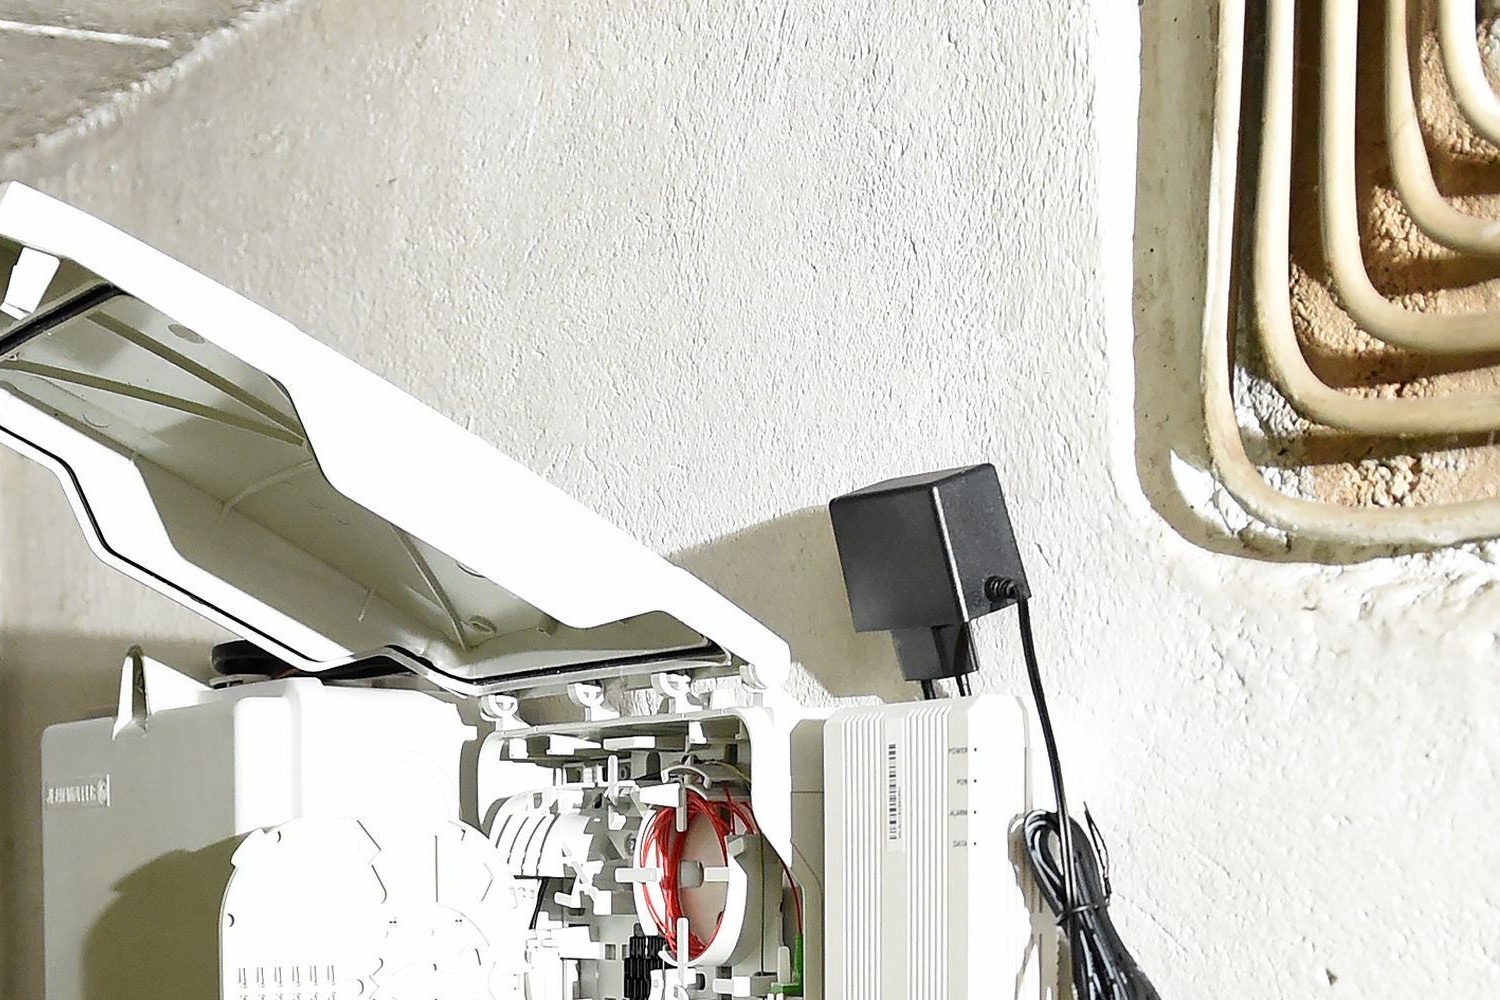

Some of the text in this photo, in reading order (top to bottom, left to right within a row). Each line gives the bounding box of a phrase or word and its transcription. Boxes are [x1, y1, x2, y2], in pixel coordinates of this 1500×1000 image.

[947, 747, 968, 755] POWER
[949, 809, 968, 817] ALARM
[952, 839, 968, 848] DATA
